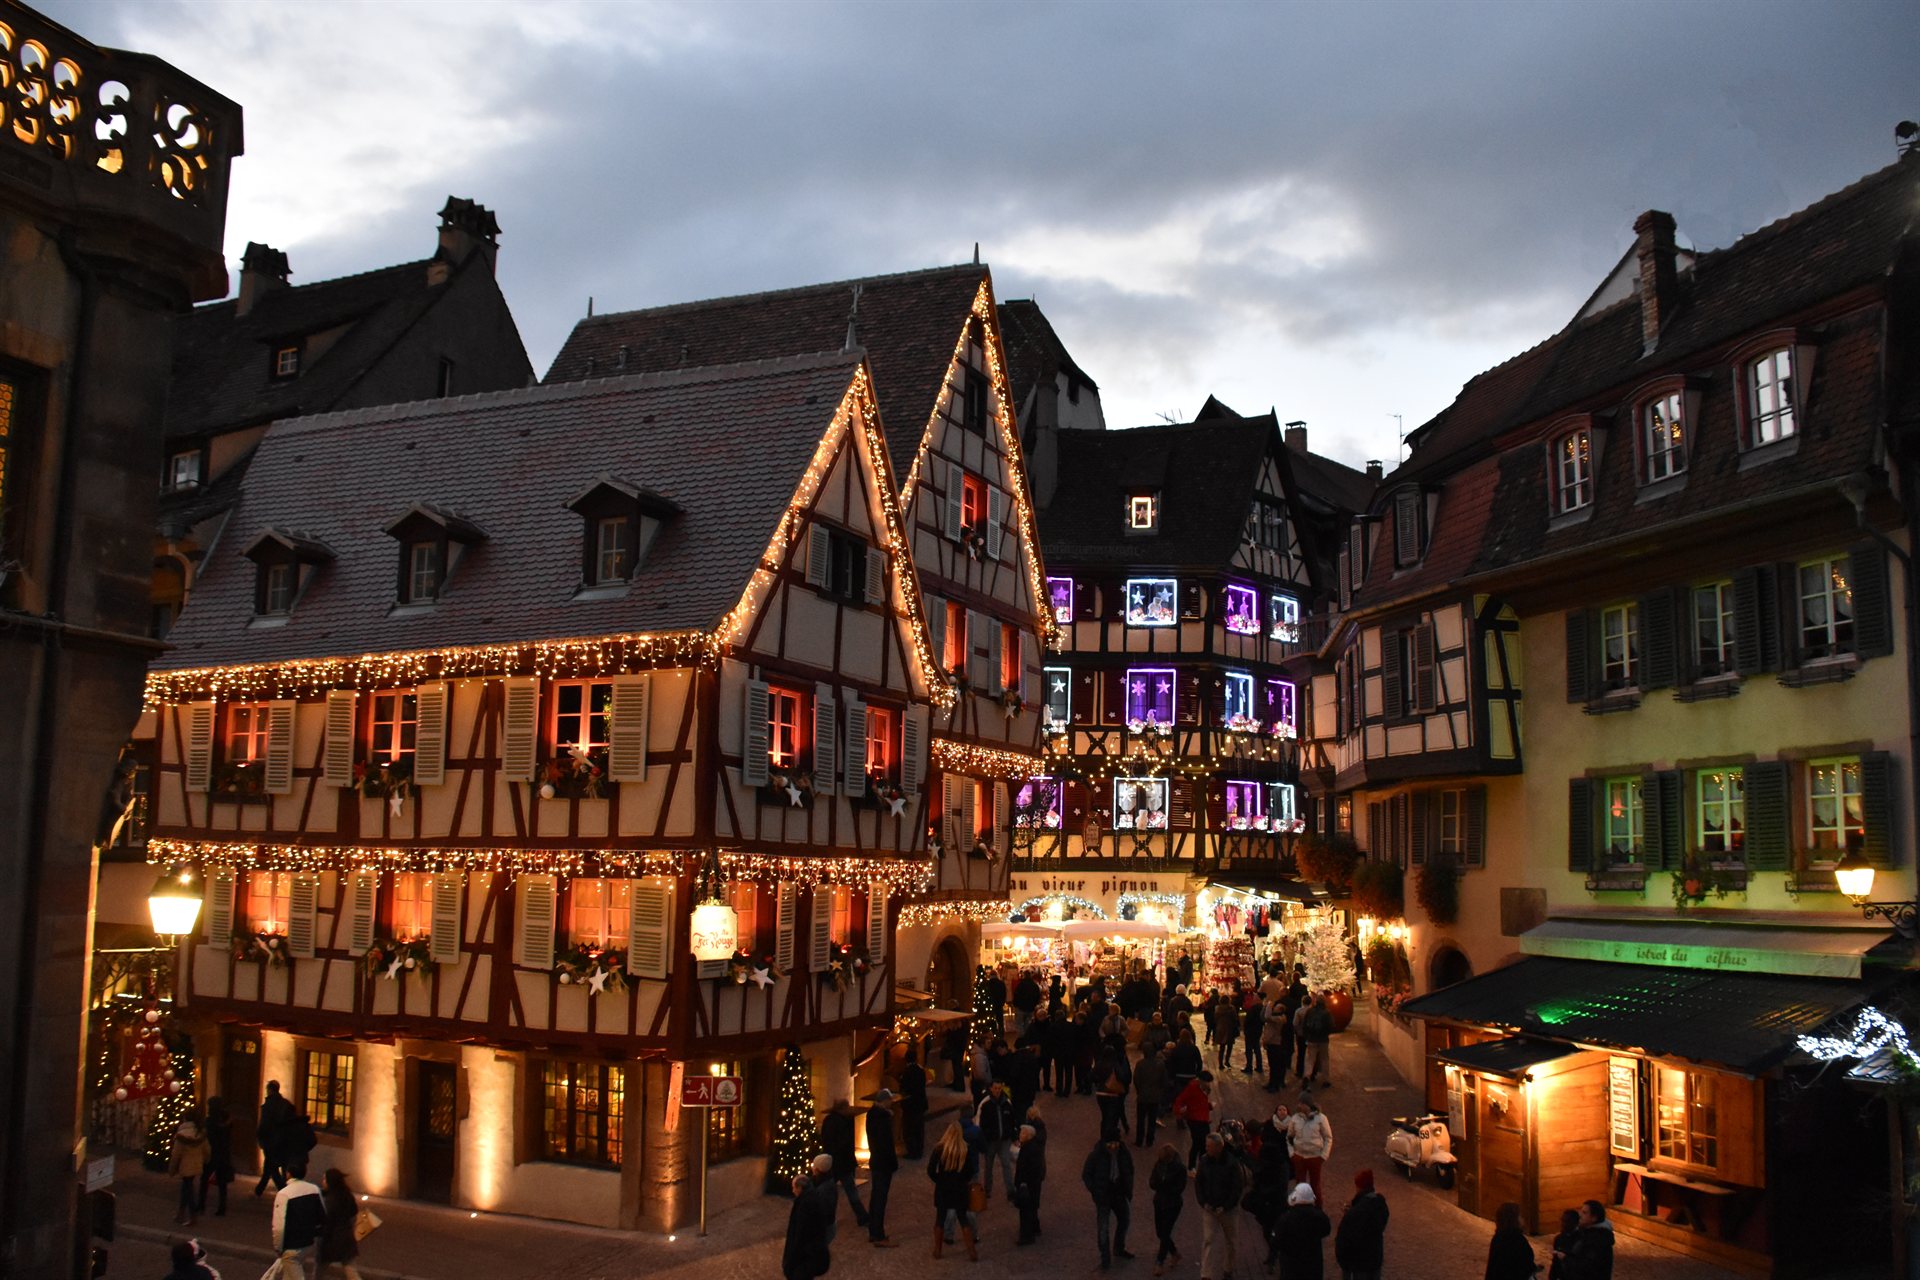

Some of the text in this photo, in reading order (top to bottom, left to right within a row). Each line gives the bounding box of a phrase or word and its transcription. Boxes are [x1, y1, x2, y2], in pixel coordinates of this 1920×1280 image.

[1010, 875, 1158, 897] au vieux pignon
[1636, 947, 1667, 961] istrot
[1671, 948, 1689, 962] du
